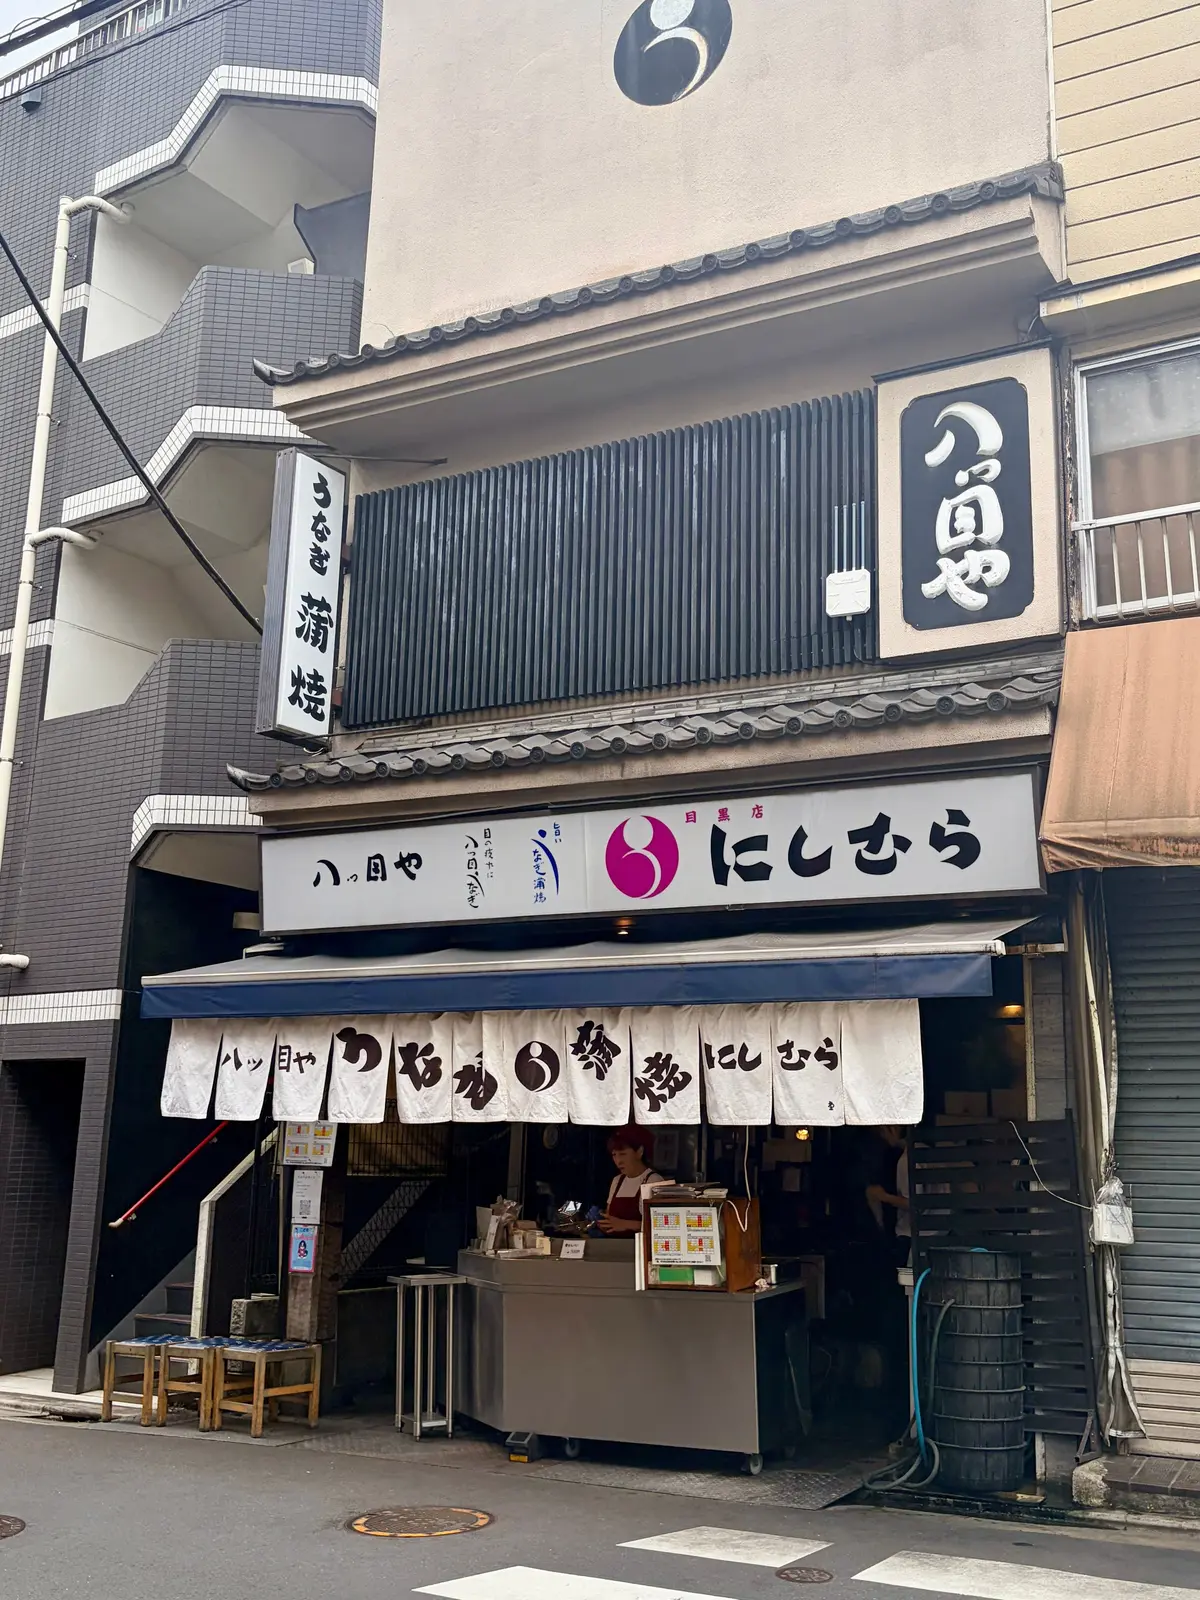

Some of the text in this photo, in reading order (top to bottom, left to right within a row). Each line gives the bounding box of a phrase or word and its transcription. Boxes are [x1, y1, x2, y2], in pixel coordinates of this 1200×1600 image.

[685, 804, 764, 824] 目黒店
[710, 808, 981, 886] にしむら
[704, 1037, 838, 1072] にしむら
